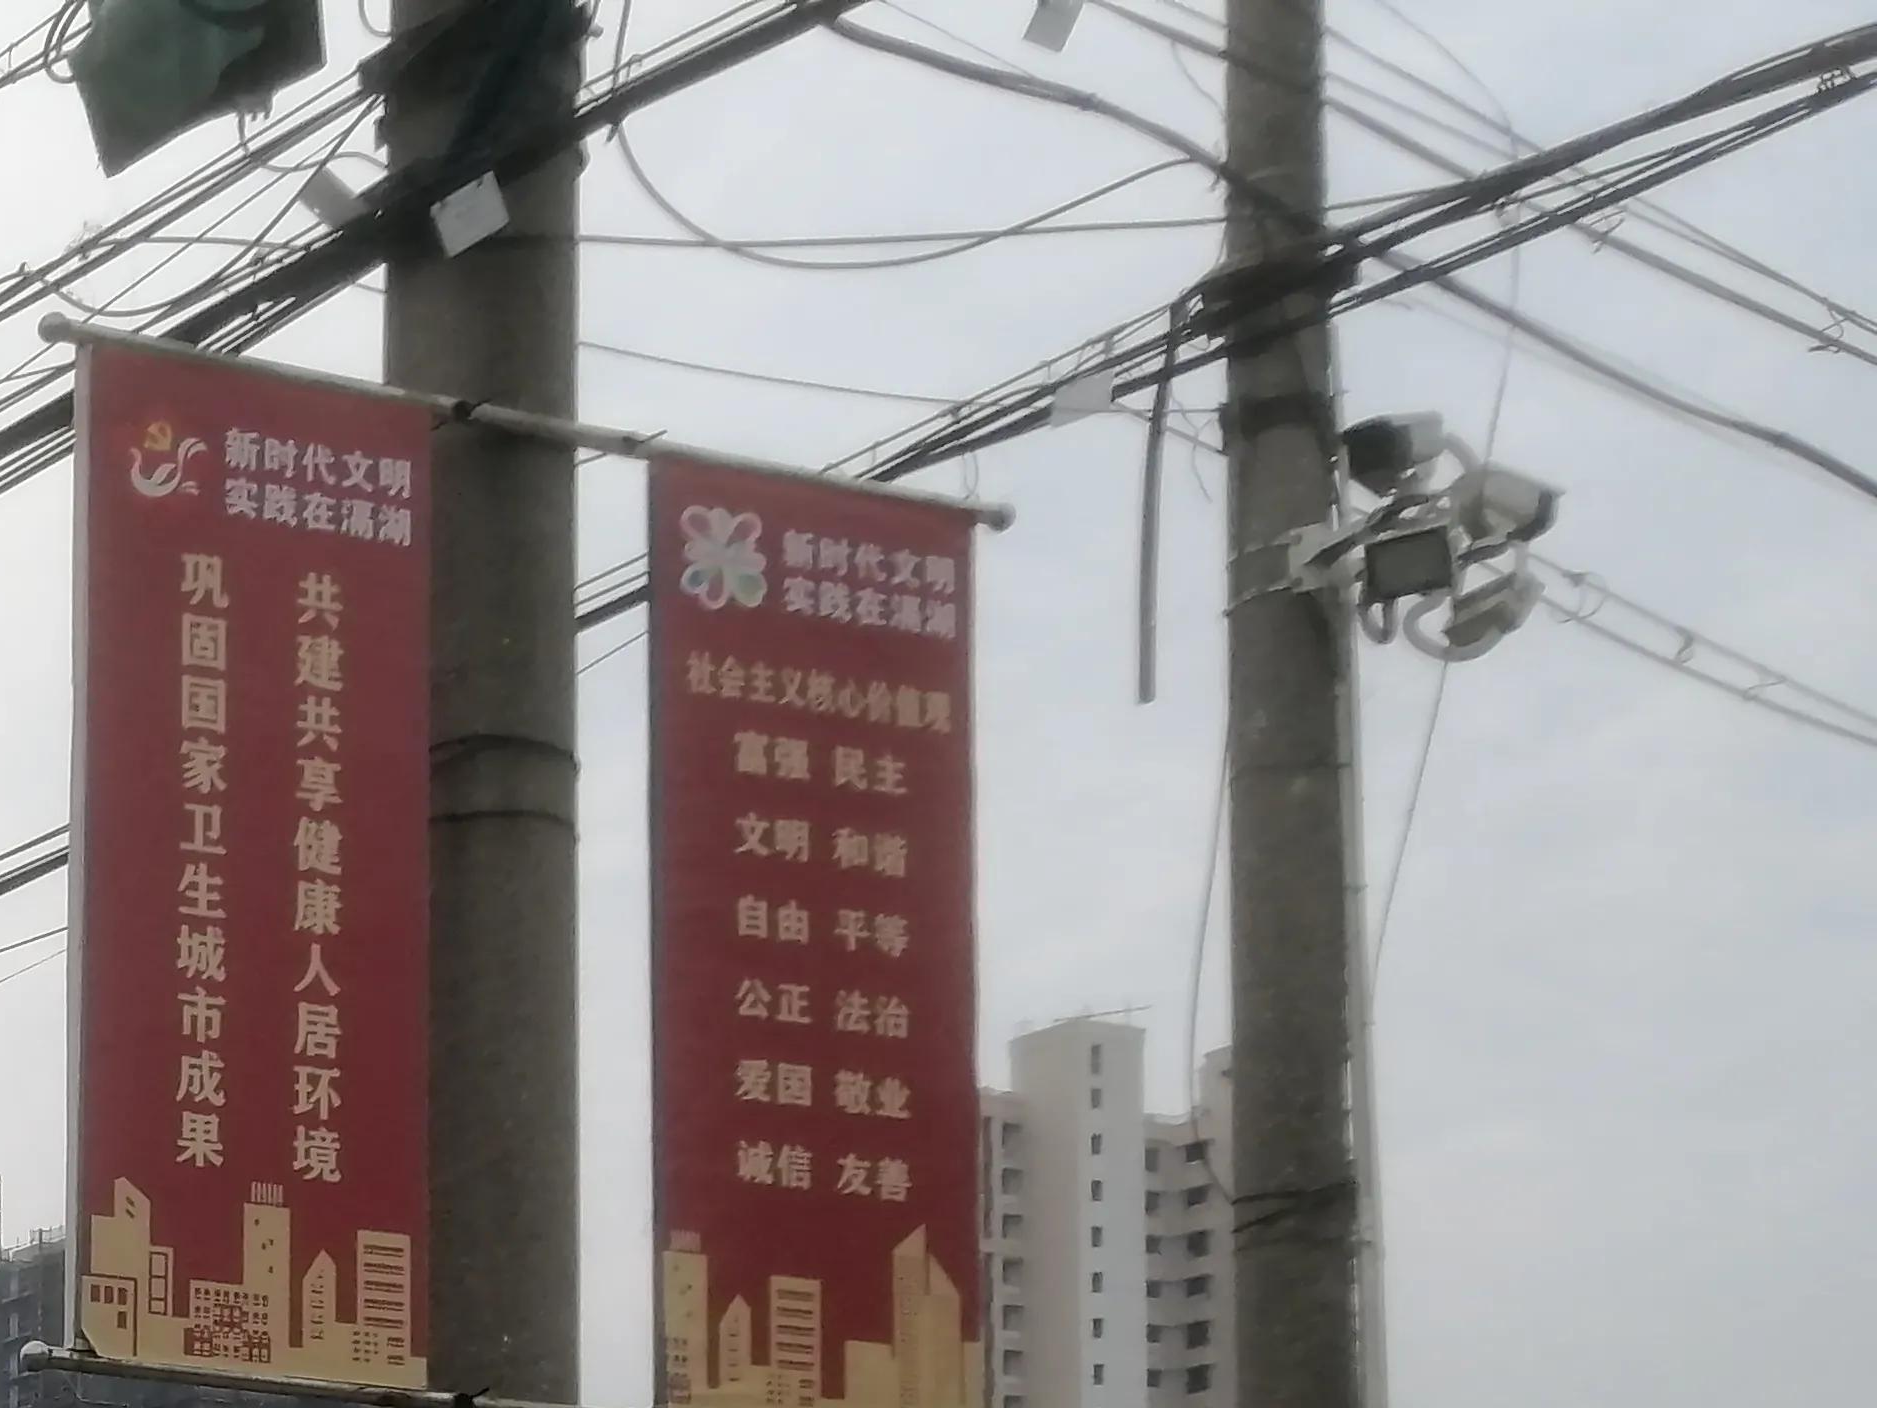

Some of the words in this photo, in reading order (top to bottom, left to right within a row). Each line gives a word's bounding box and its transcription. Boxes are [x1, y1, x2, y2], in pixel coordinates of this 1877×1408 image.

[226, 427, 411, 498] 新时代文明
[783, 529, 955, 594] 新时代文明
[687, 651, 951, 733] 社会主义核心价值观
[734, 731, 810, 779] 富强
[834, 745, 909, 794] 民主
[176, 551, 227, 1168] 巩固国家卫生城市成果
[735, 812, 809, 862] 文明
[832, 827, 908, 877] 和谐
[293, 571, 344, 1184] 共建共享健康人居环境
[738, 894, 809, 943] 自由
[834, 909, 909, 957] 平等
[735, 977, 812, 1023] 公正
[836, 989, 910, 1038] 法治
[734, 1058, 812, 1106] 爱国
[835, 1069, 912, 1118] 敬业
[737, 1141, 813, 1189] 诚信
[836, 1152, 913, 1201] 友善
